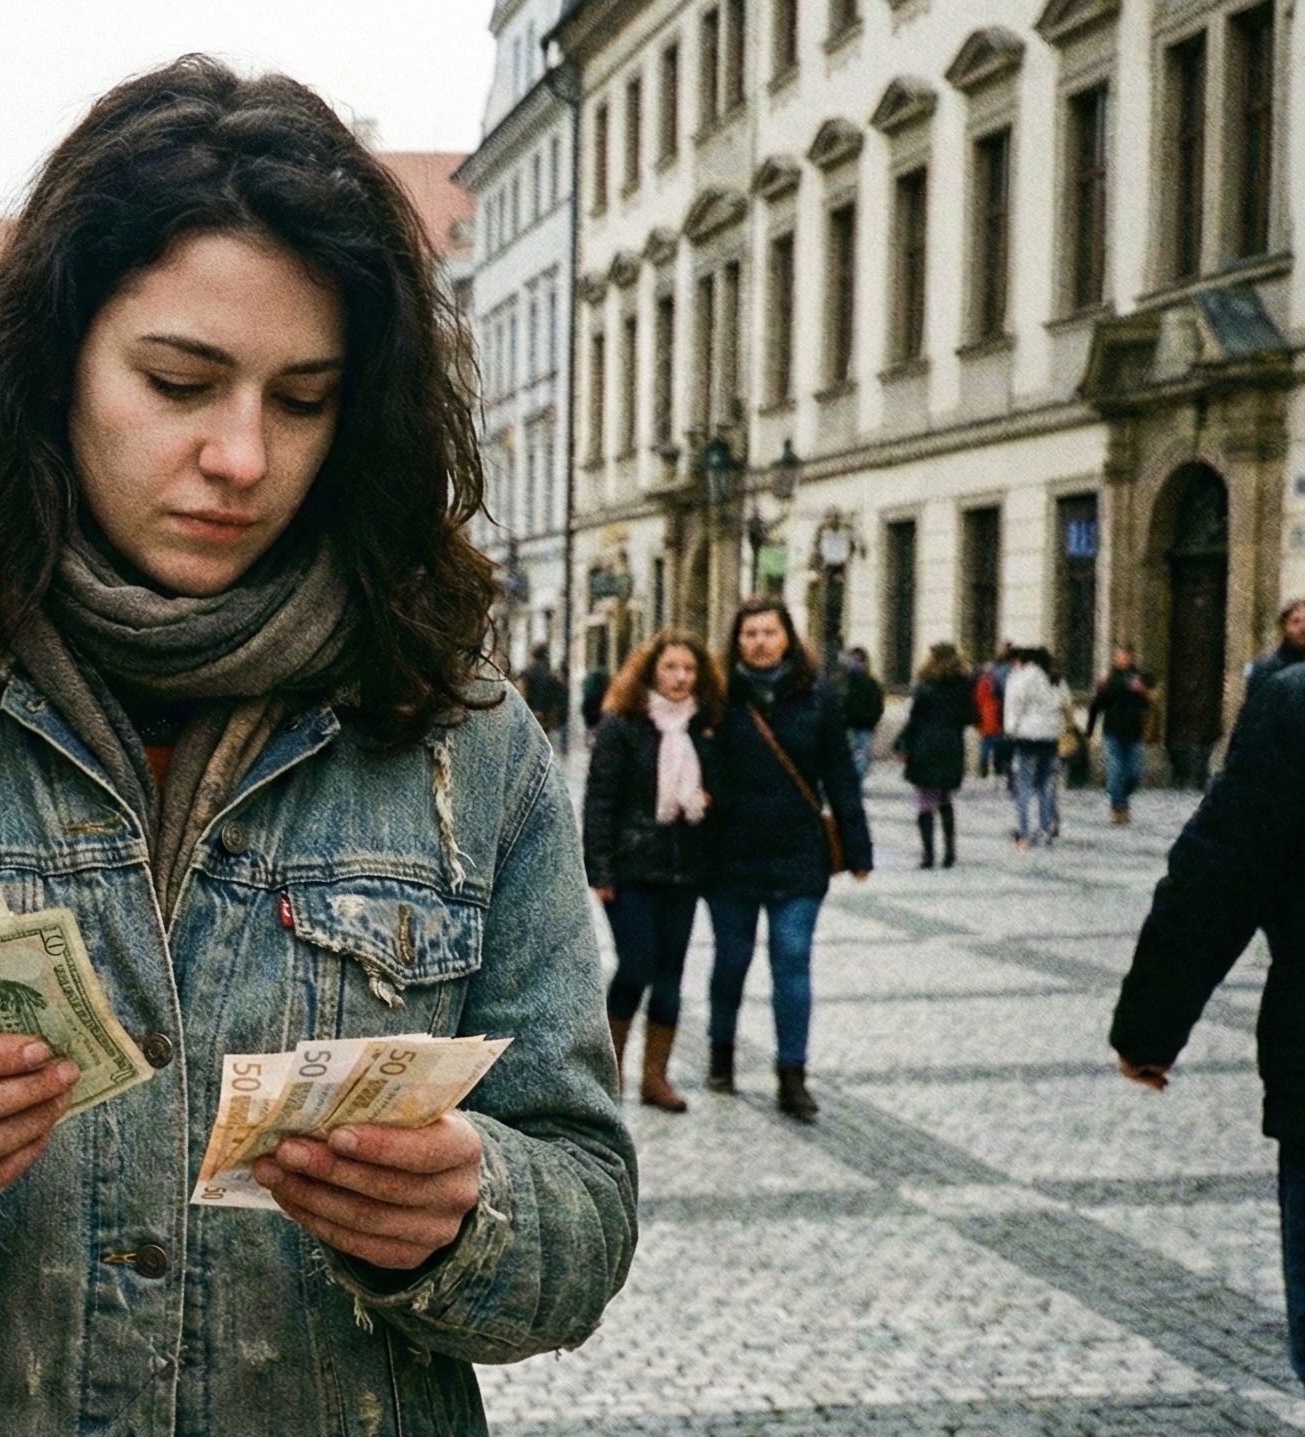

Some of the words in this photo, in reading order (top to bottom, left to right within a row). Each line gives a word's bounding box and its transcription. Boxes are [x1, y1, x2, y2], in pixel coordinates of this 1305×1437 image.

[299, 1050, 333, 1078] 50
[379, 1048, 417, 1076] 50
[231, 1062, 262, 1093] 50
[200, 1186, 227, 1200] 50
